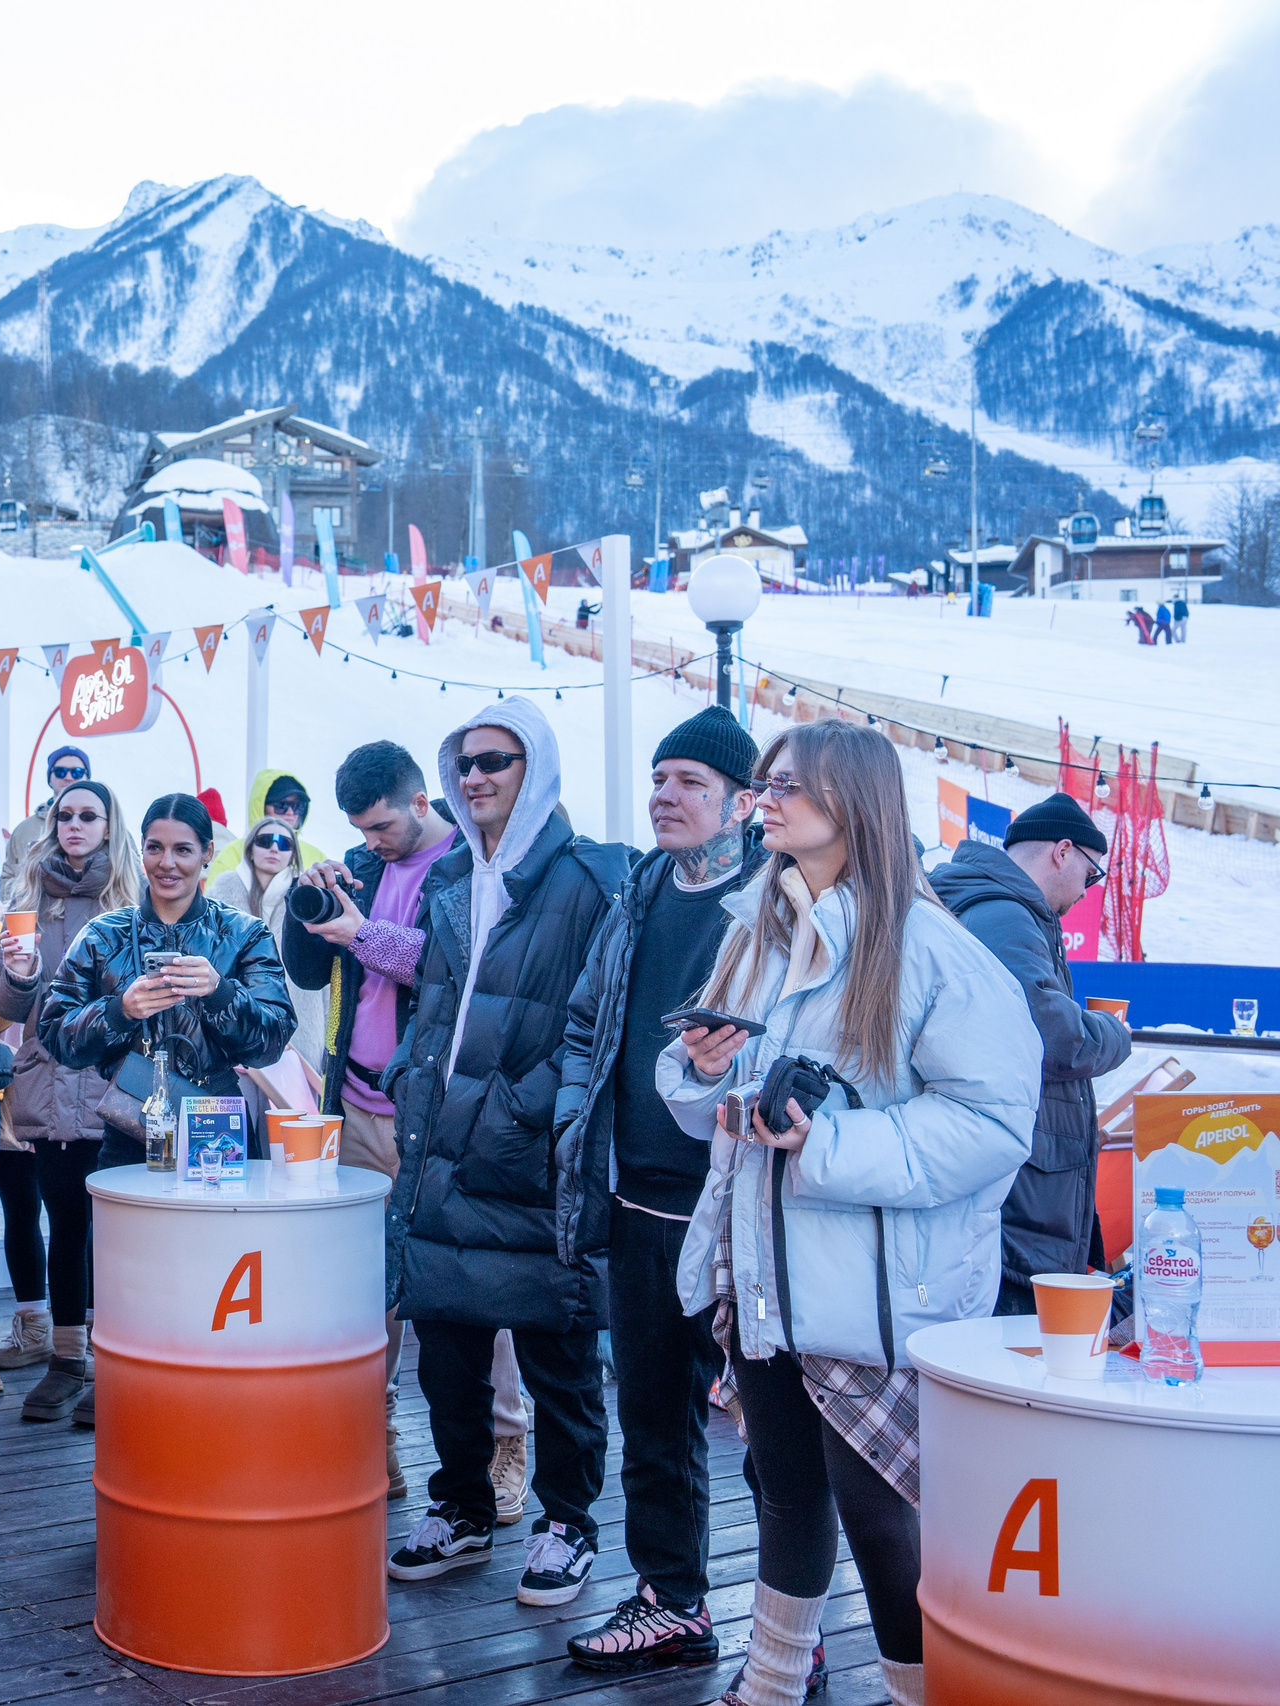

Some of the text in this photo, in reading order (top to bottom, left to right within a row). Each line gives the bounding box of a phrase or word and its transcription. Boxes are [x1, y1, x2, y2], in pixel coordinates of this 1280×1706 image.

[533, 562, 546, 584] A
[477, 577, 489, 596] A
[422, 590, 435, 611] A
[368, 603, 379, 623] A
[255, 625, 267, 643] A
[311, 614, 323, 634] A
[149, 640, 161, 657] A
[203, 632, 215, 651] A
[52, 649, 63, 667] A
[102, 645, 114, 665] A
[186, 1105, 209, 1113] ВМЕСТЕ
[220, 1105, 243, 1113] ВЫСОТЕ
[1182, 1100, 1235, 1116] ГОРЫ ЗОВУТ
[1210, 1103, 1262, 1119] АПЕРОЛИТЬ
[321, 1128, 339, 1160] A
[1194, 1123, 1250, 1149] APEROL
[211, 1250, 262, 1331] A
[988, 1478, 1060, 1598] A
